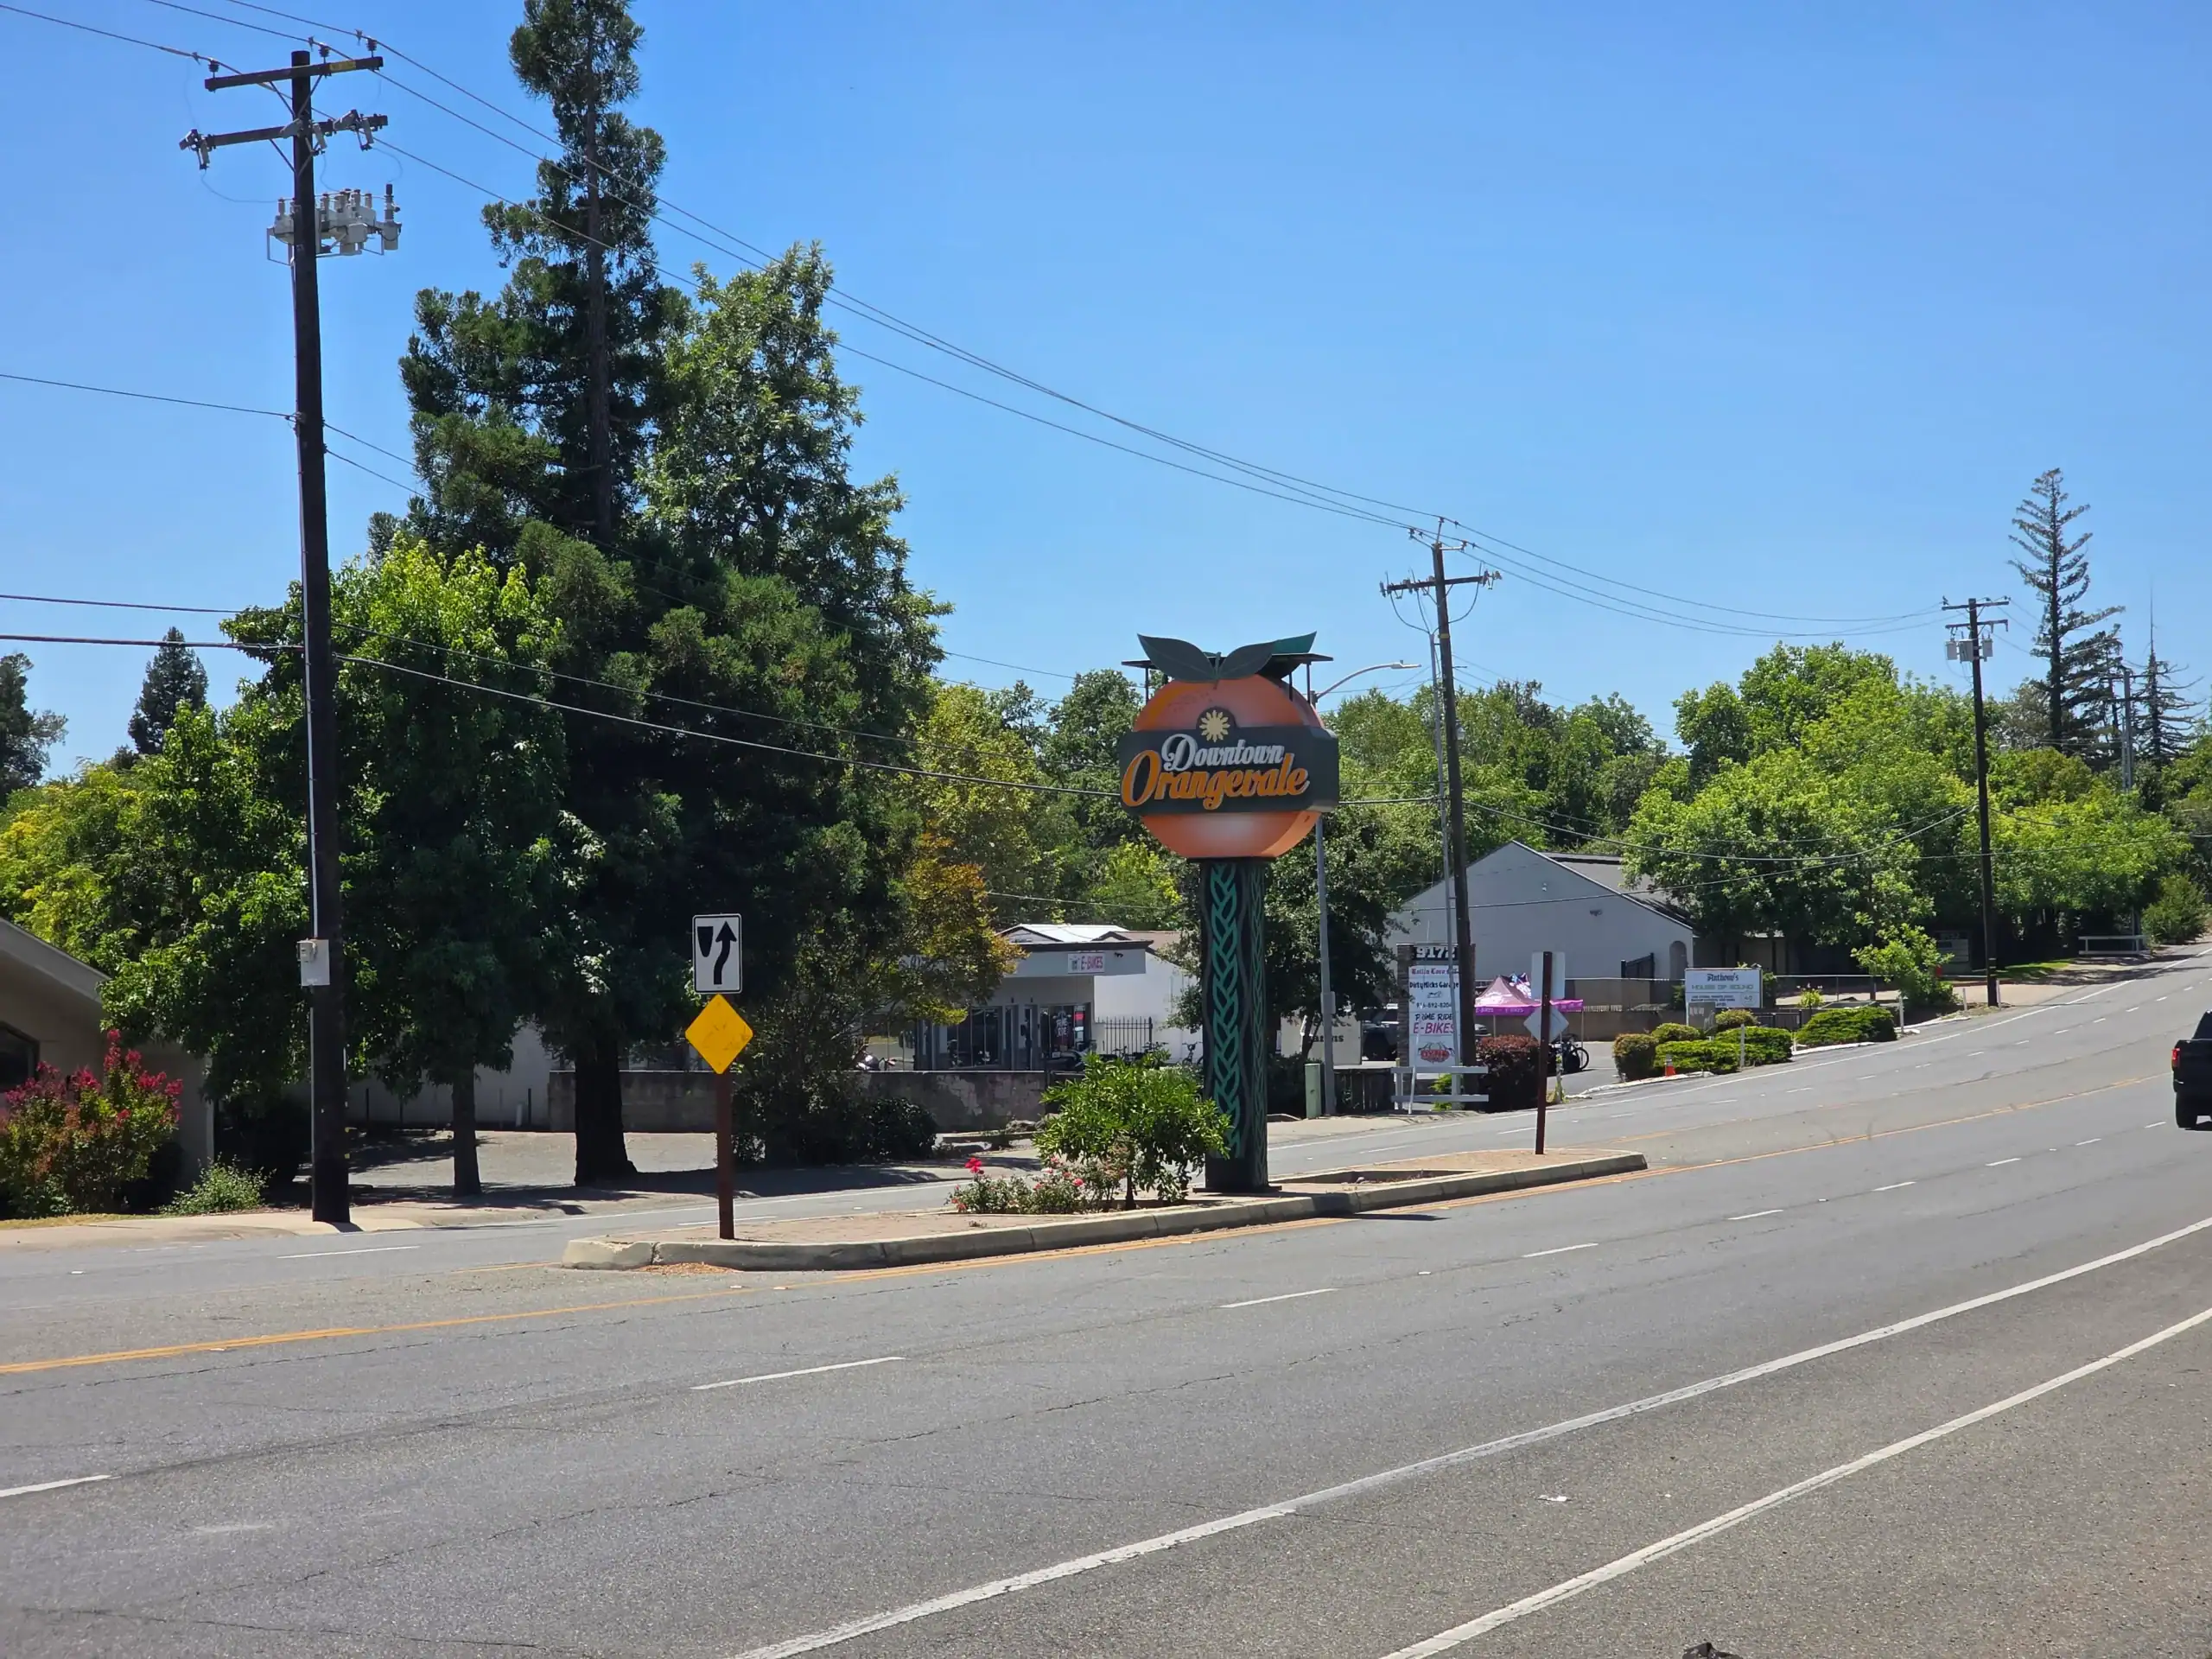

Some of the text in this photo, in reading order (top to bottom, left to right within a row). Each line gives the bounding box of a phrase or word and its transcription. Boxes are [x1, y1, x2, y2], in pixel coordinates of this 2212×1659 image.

[1161, 734, 1285, 772] Downtown
[1121, 749, 1310, 810] Orangevale
[1416, 946, 1455, 958] 9172
[1439, 981, 1459, 989] Garge
